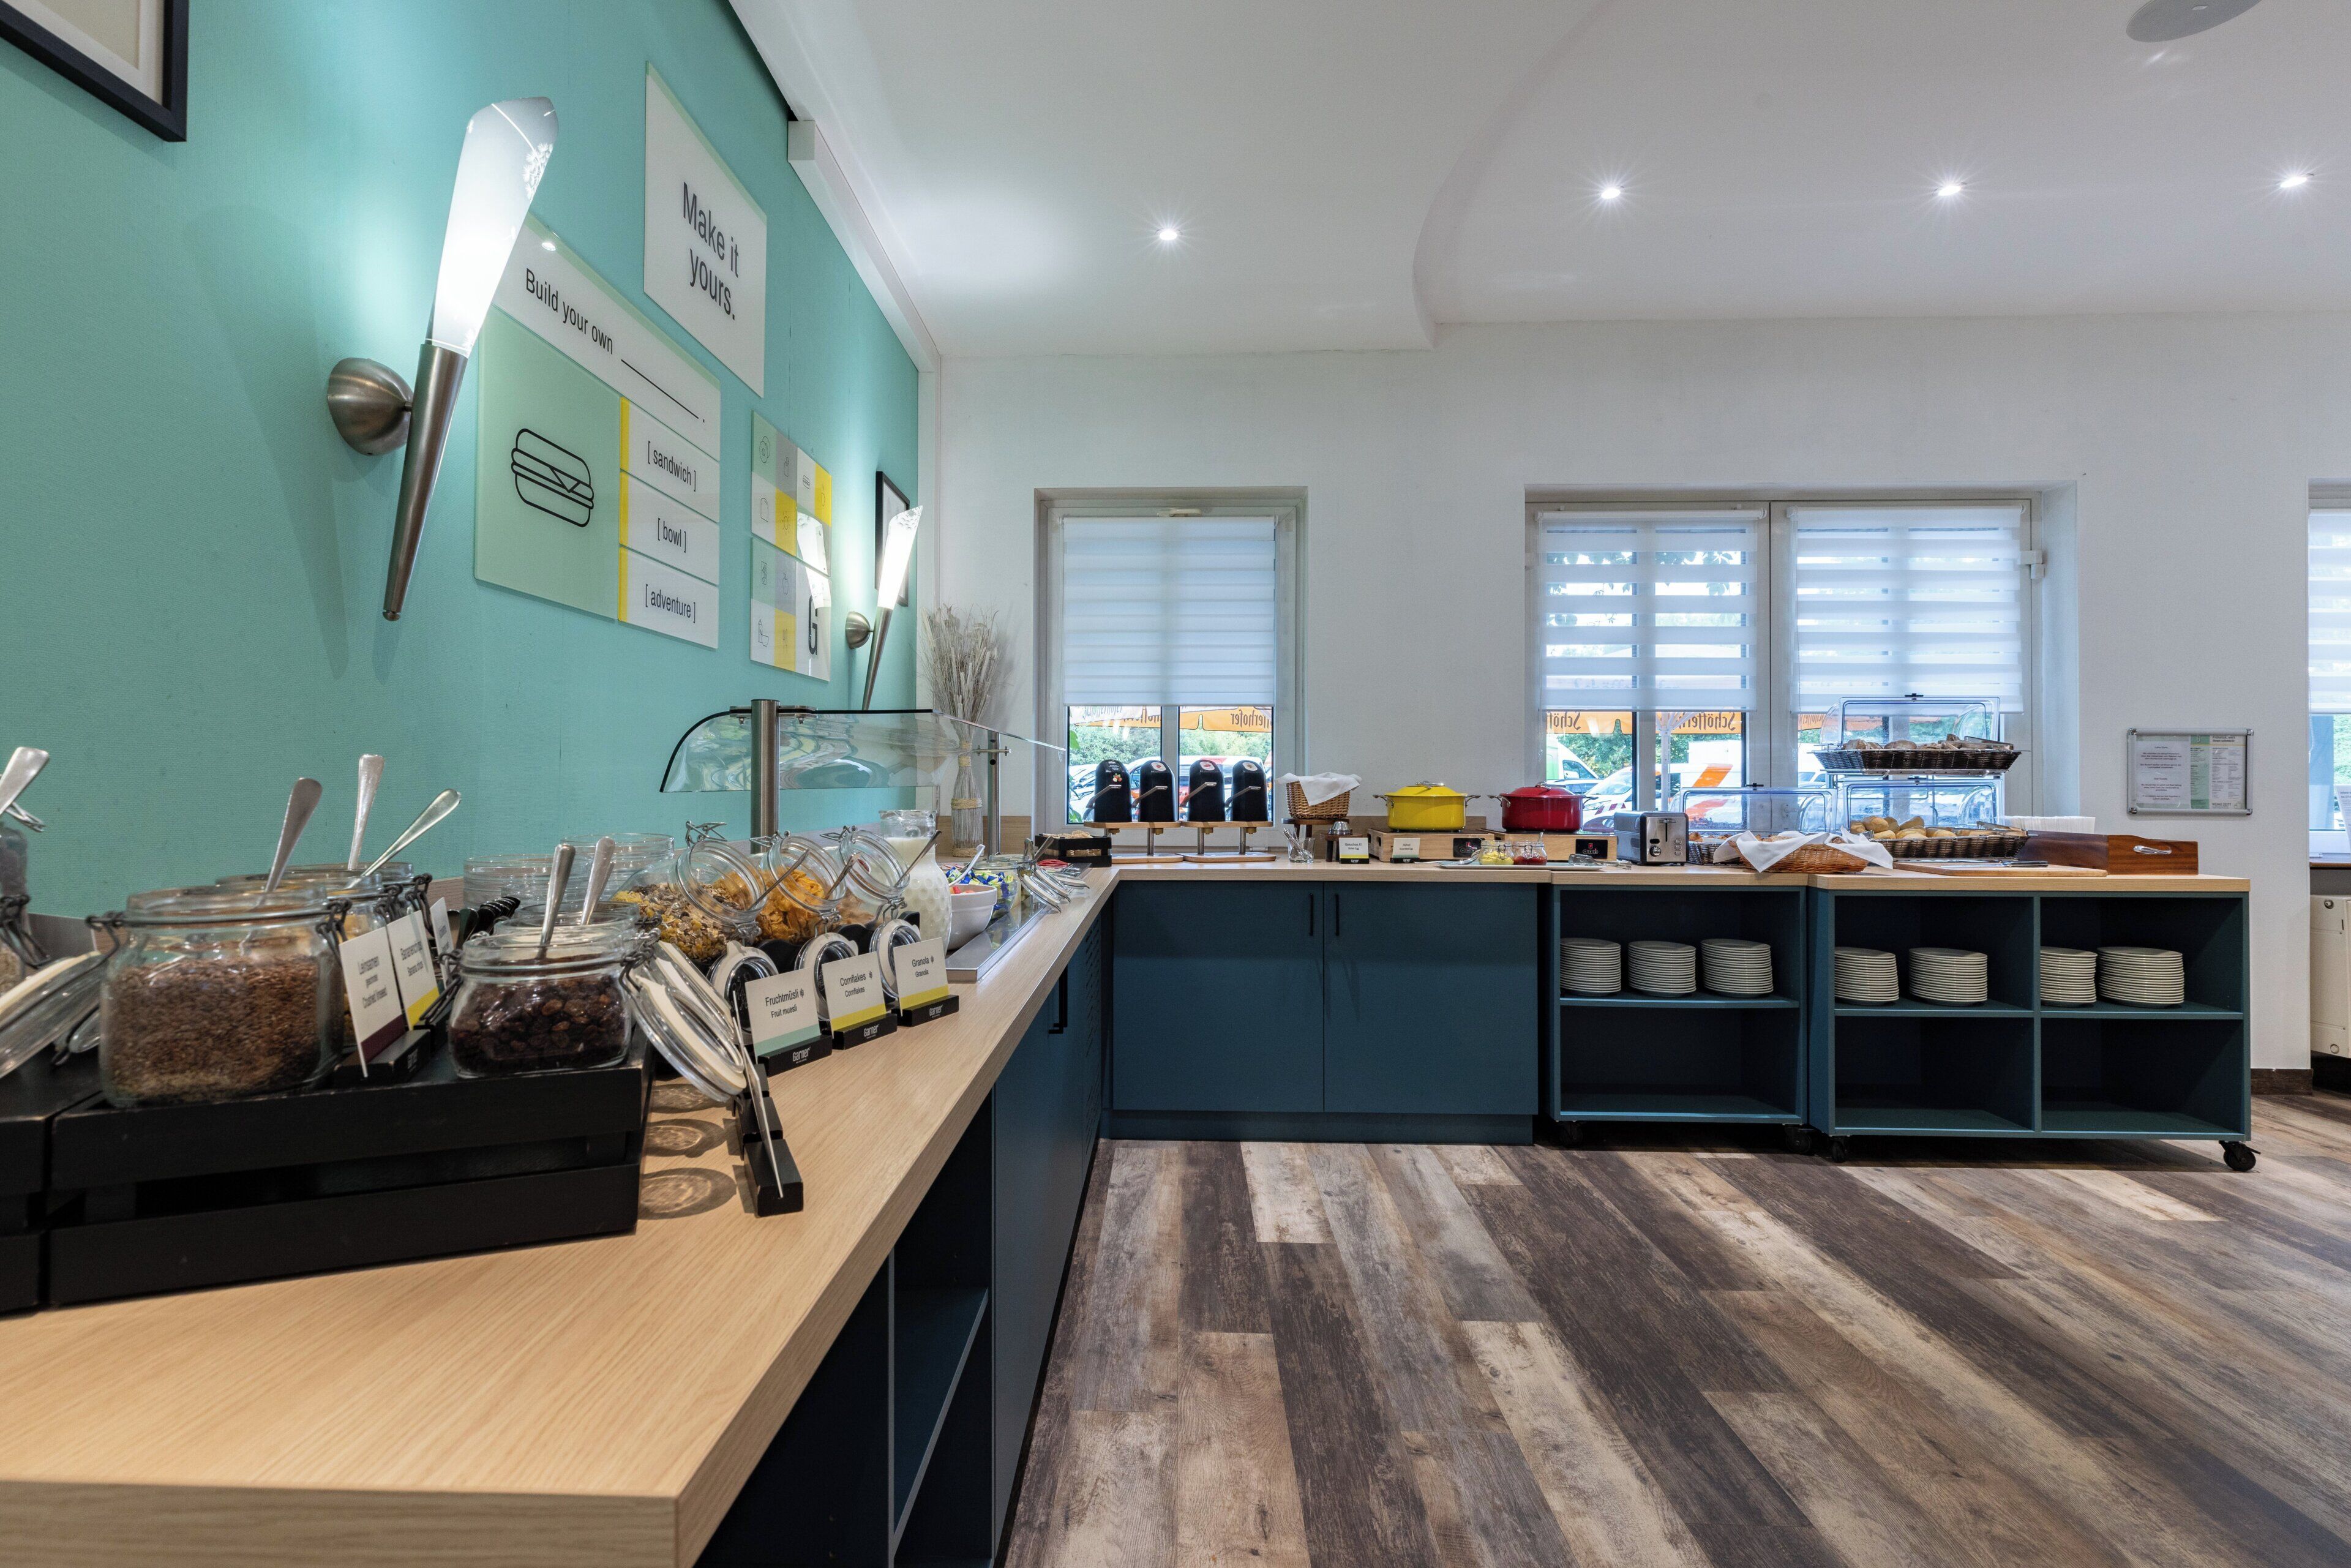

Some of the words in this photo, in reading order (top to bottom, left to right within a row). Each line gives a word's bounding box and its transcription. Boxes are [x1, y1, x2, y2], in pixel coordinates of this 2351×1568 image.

[683, 182, 725, 261] Make
[731, 236, 739, 278] it
[690, 249, 735, 320] yours.
[526, 268, 558, 312] Build
[563, 301, 588, 334] your
[591, 326, 612, 354] own
[912, 956, 929, 967] Granola
[839, 973, 866, 986] Cornflakes
[915, 969, 929, 978] Granola
[765, 989, 799, 1007] Fruchtmüsli
[845, 986, 865, 997] Cornflakes
[771, 1008, 782, 1018] Fruit
[782, 1005, 797, 1015] muesli
[792, 1047, 810, 1062] Garner
